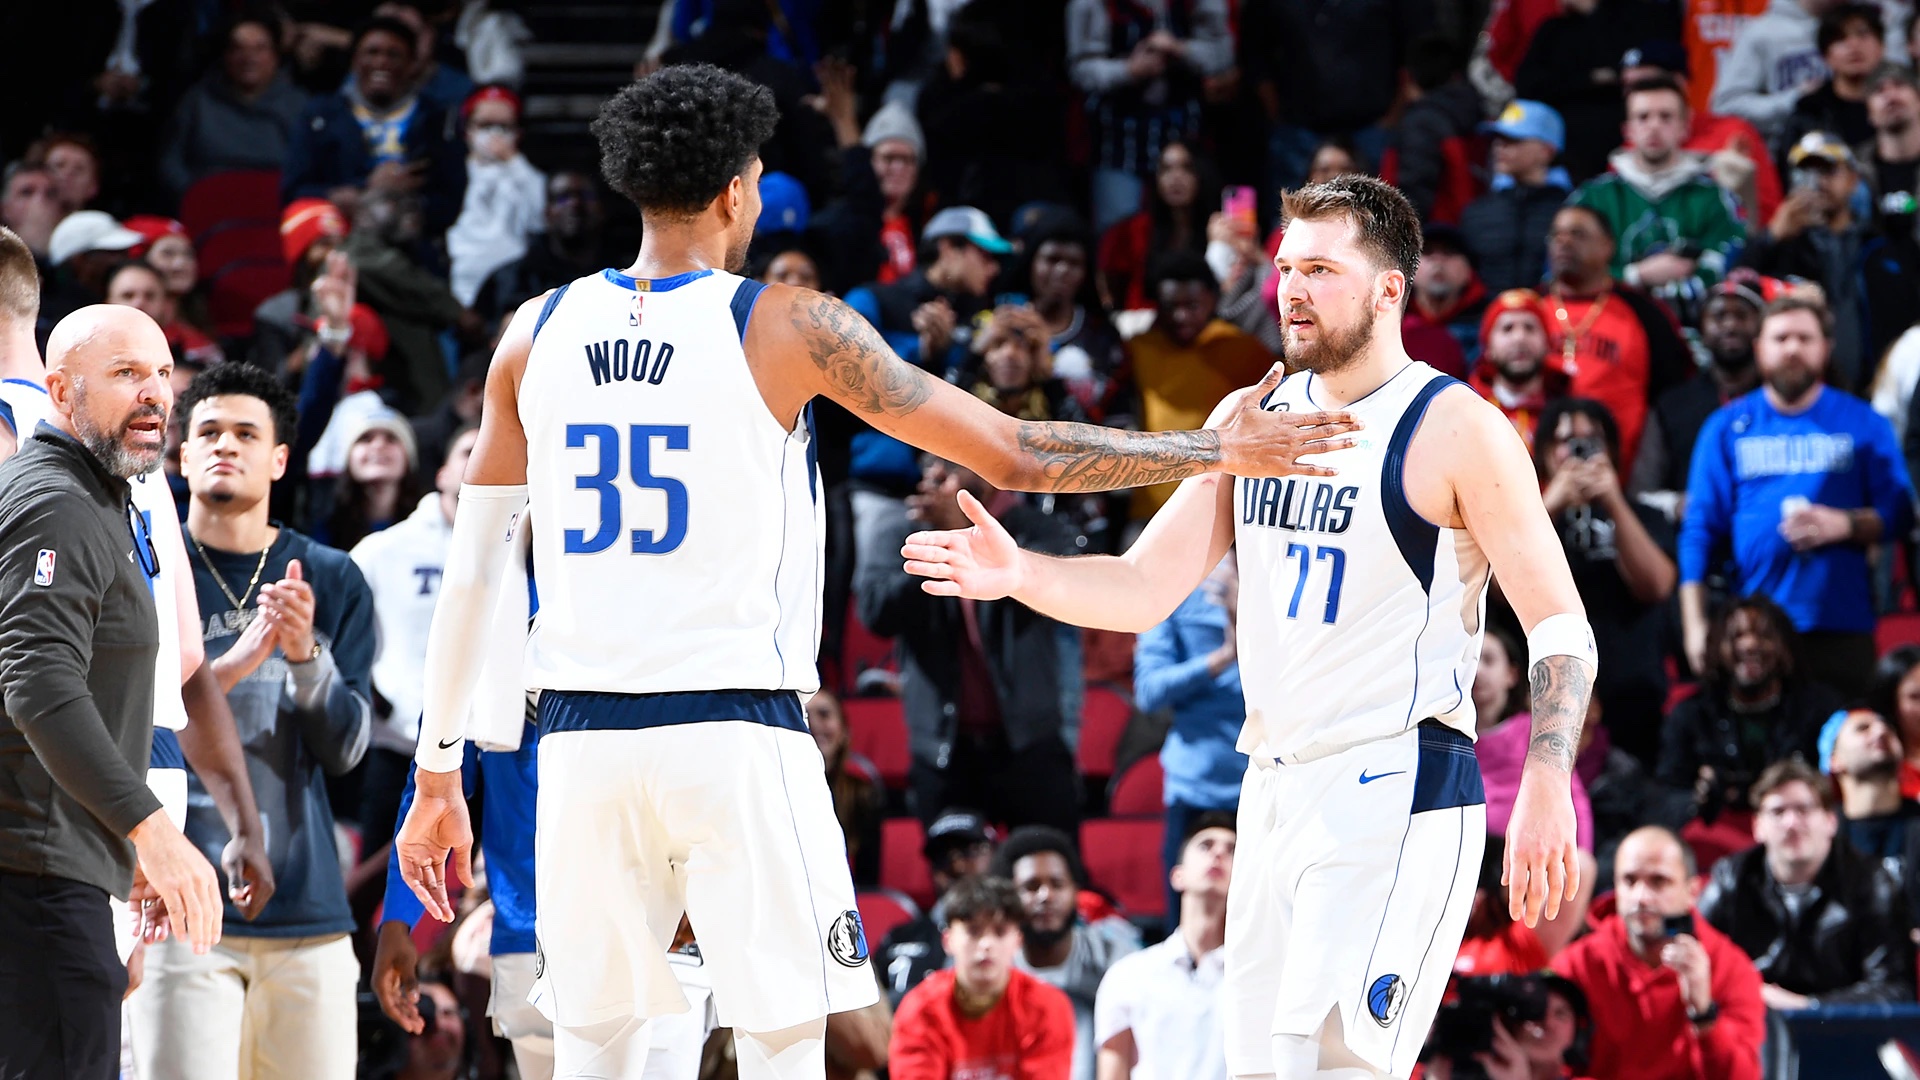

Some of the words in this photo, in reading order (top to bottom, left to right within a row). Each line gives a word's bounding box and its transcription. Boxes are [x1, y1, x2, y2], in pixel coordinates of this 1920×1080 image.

[584, 338, 675, 387] WOOD
[563, 422, 692, 557] 35
[1242, 476, 1362, 535] DALLAS
[1285, 541, 1348, 627] 77
